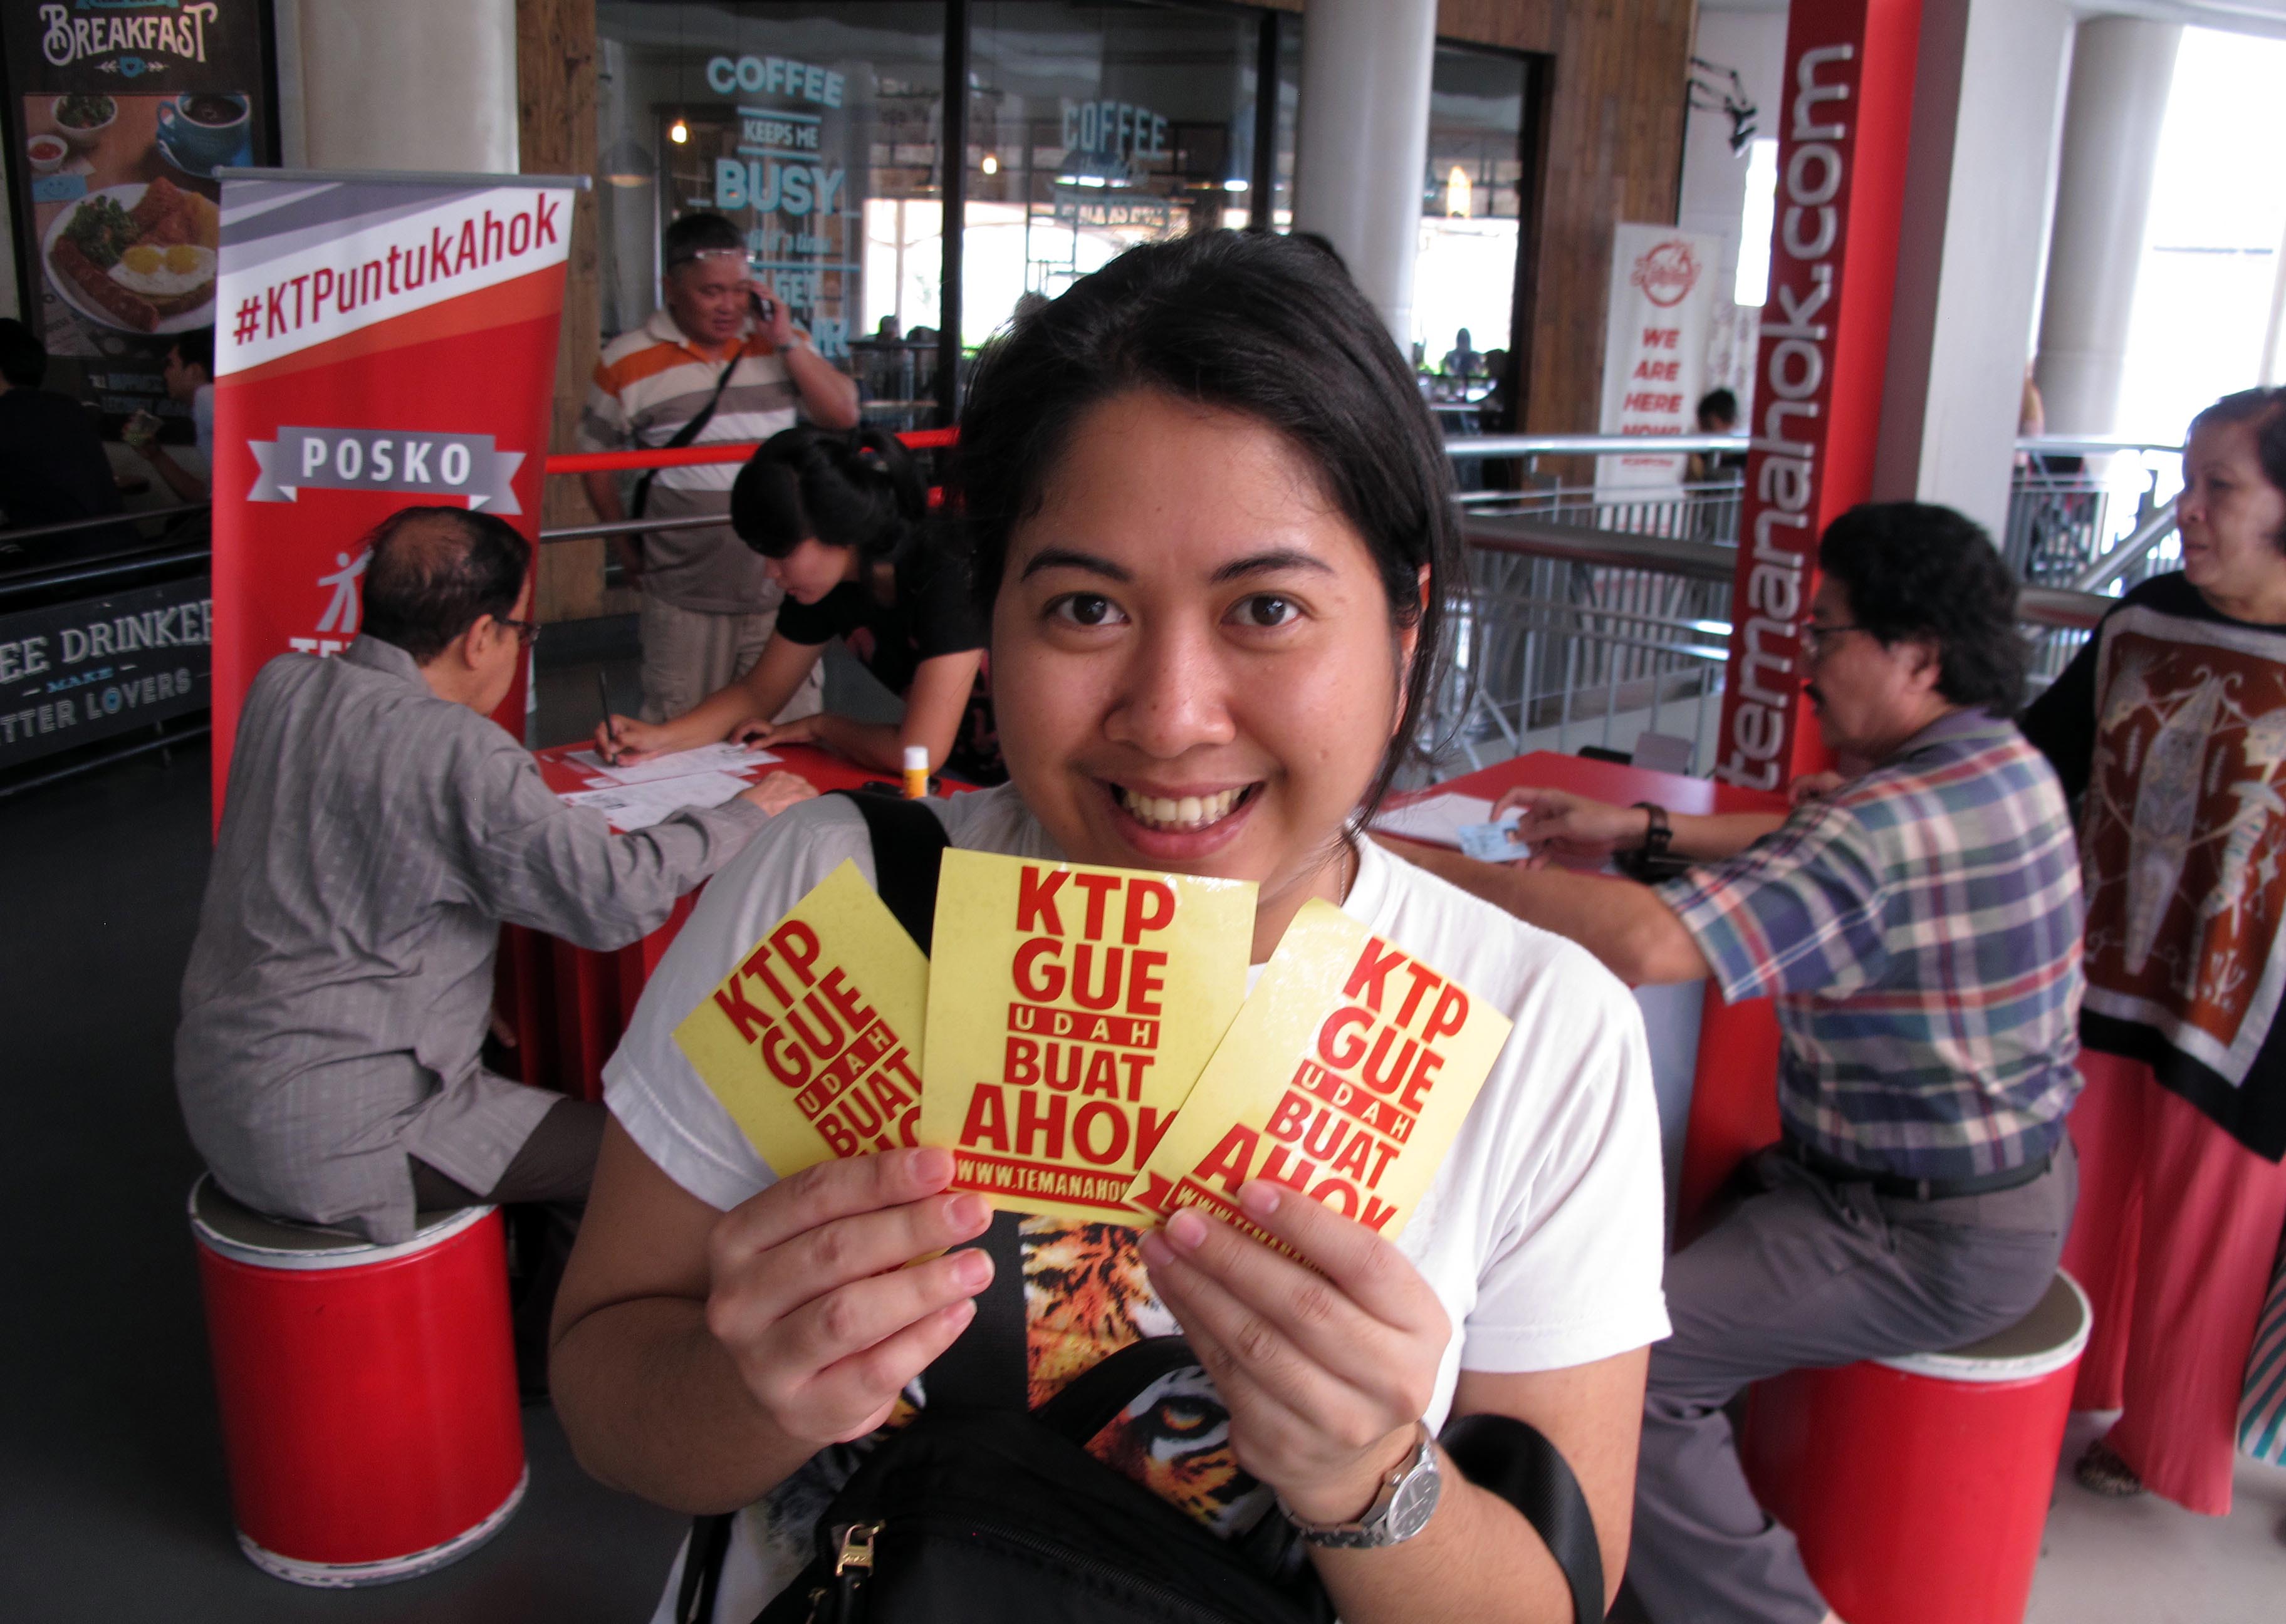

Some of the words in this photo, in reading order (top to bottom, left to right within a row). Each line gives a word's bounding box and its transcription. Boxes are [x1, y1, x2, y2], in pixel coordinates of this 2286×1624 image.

[40, 4, 217, 65] BREAKFAST
[706, 56, 845, 108] COFFEE
[743, 120, 793, 147] KEEPS
[796, 126, 819, 148] ME
[1062, 100, 1168, 161] COFFEE
[716, 159, 845, 216] BUSY
[233, 192, 560, 346] #KTPuntukAhok
[1633, 361, 1681, 382] ARE
[1642, 328, 1680, 350] WE
[1624, 392, 1684, 414] HERE
[1718, 43, 1853, 791] temanahok.com
[302, 437, 471, 486] POSKO
[46, 667, 114, 693] MAKE
[85, 668, 192, 721] LOVERS
[1016, 865, 1176, 945] KTP
[713, 919, 822, 1044] KTP
[1013, 937, 1168, 1016] GUE
[1342, 935, 1469, 1045] KTP
[761, 966, 878, 1089] GUE
[1015, 1006, 1152, 1046] UDAH
[798, 1028, 892, 1114] UDAH
[1003, 1035, 1156, 1102] BUAT
[1318, 1006, 1446, 1115] GUE
[815, 1046, 922, 1158] BUAT
[1302, 1064, 1409, 1139] UDAH
[1265, 1091, 1400, 1190] BUAT
